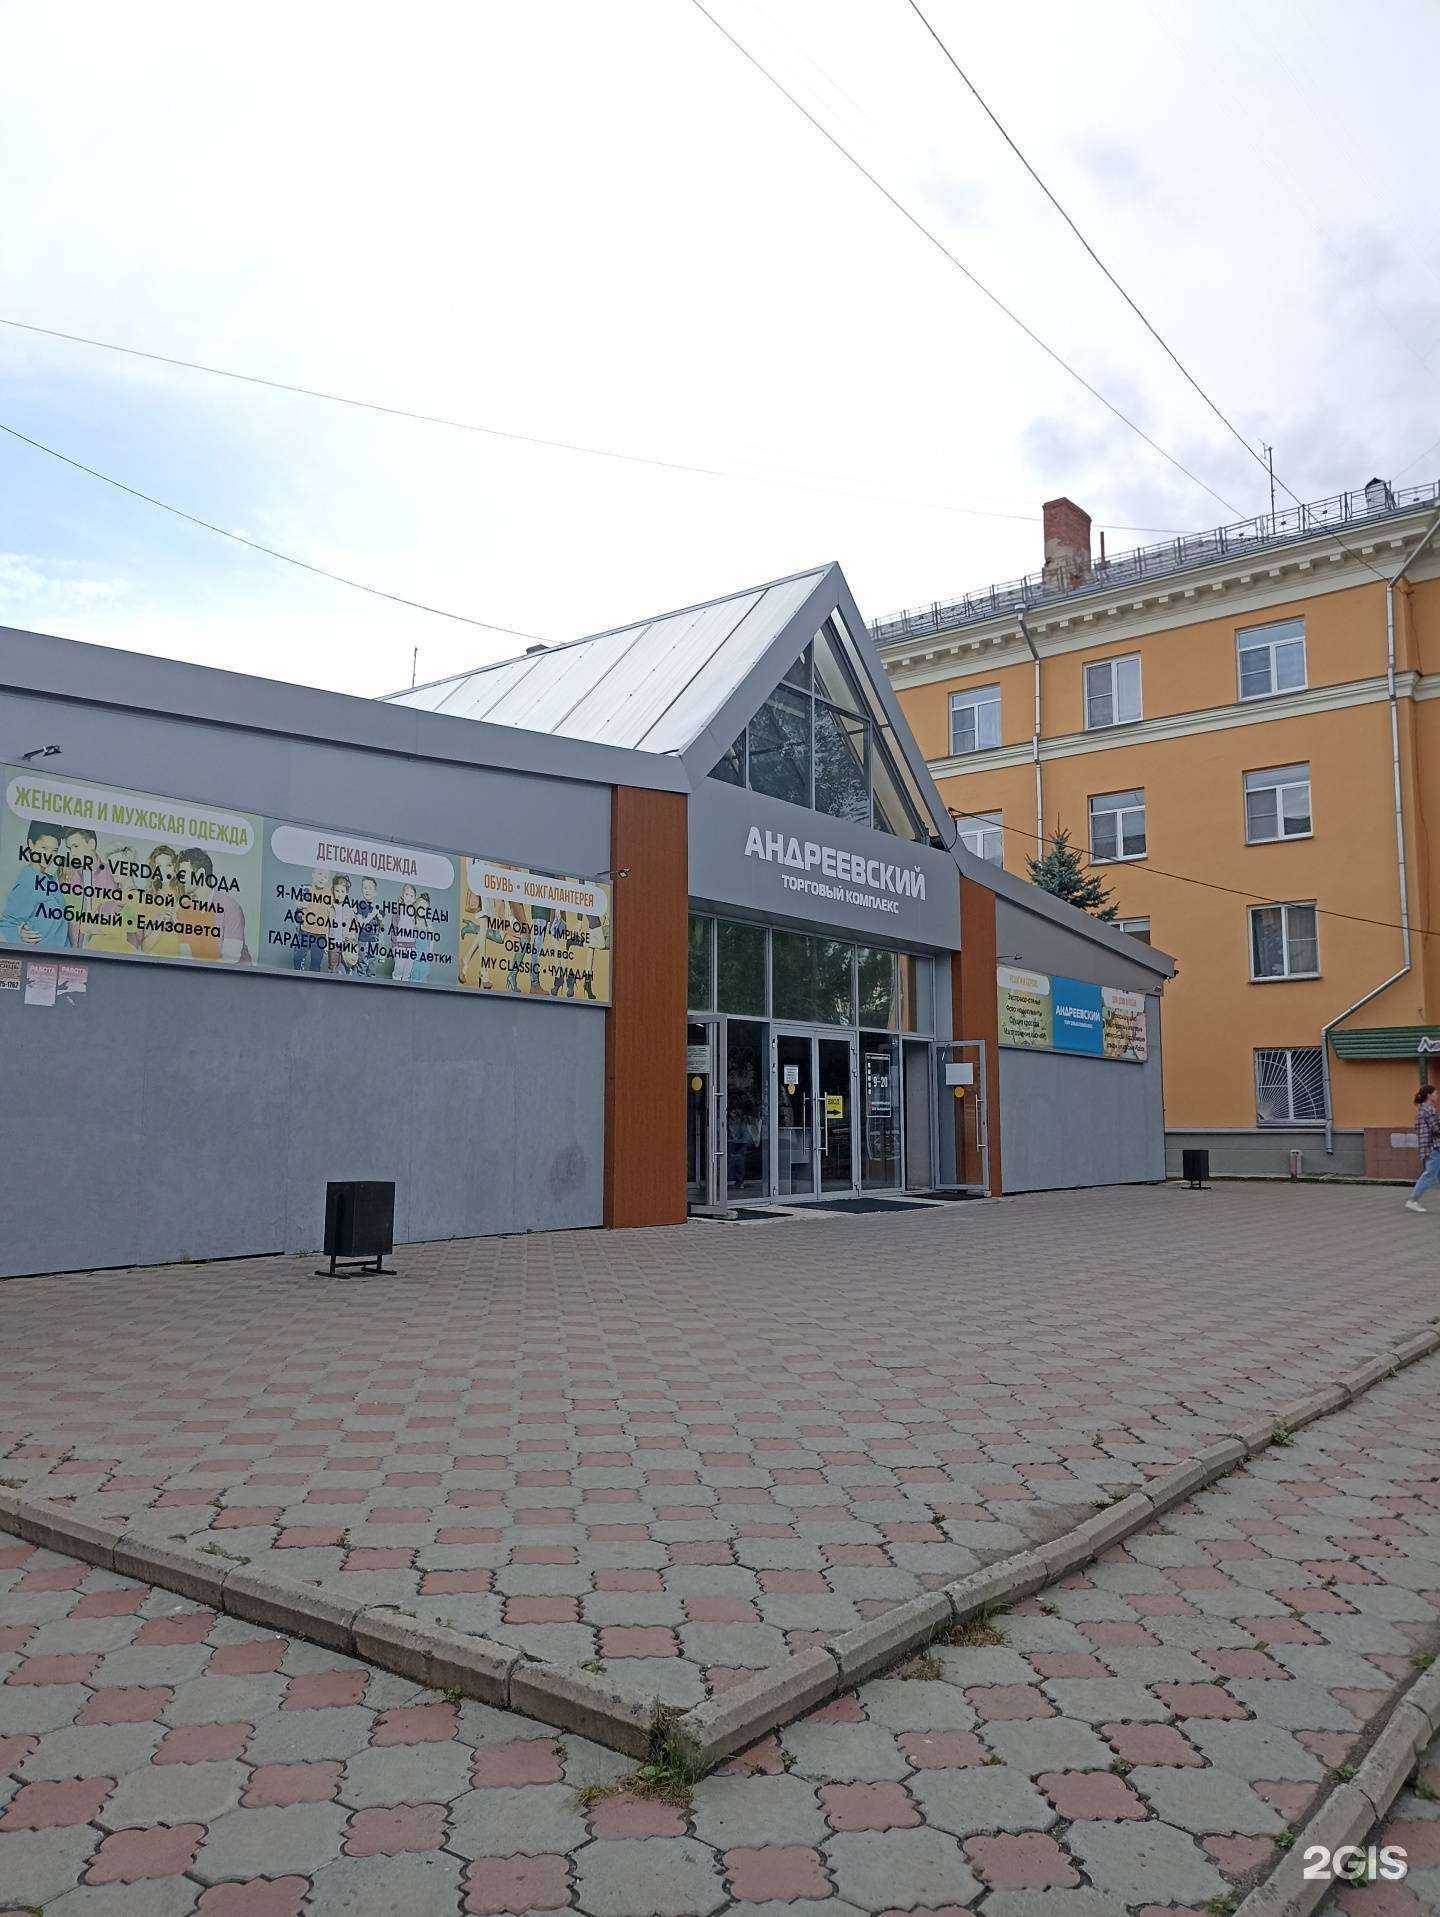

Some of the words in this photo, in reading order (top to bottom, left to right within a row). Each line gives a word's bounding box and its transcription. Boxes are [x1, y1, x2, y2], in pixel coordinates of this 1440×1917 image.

[15, 786, 93, 818] ЖЕНСКАЯ
[97, 803, 107, 821] И
[112, 804, 185, 835] МУЖСКАЯ
[189, 819, 248, 846] ОДЕЖДА
[19, 845, 93, 870] KavaleR
[108, 859, 163, 881] VERDA
[191, 872, 240, 892] МОДА
[317, 842, 368, 866] ДЕТСКАЯ
[371, 852, 417, 876] ОДЕЖДА
[744, 826, 926, 900] АНДРЕЕВСКИЙ
[34, 875, 122, 900] Красотка
[137, 889, 174, 908] Твой
[179, 894, 224, 914] Стиль
[276, 885, 332, 904] Я-Мама
[342, 895, 373, 911] Аист
[383, 901, 449, 923] НЕПОСЕДЫ
[484, 874, 513, 893] ОБУВЬ
[524, 882, 594, 907] КОЖГАЛАНТЕРЕЯ
[781, 874, 844, 901] ТОРГОВЫЙ
[845, 889, 899, 914] КОМПЛЕКС
[34, 903, 122, 927] Любимый
[137, 915, 220, 938] Елизавета
[284, 910, 338, 928] АССоль
[349, 918, 378, 935] Дуэт
[388, 924, 441, 942] Лимпопо
[487, 918, 511, 931] МИР
[513, 922, 547, 936] ОБУВИ
[269, 930, 358, 953] ГАРДЕРОБчик
[368, 943, 417, 960] Модные
[420, 952, 452, 964] детки
[539, 948, 555, 958] для
[557, 951, 574, 960] вас
[481, 957, 497, 969] MY
[499, 959, 541, 974] CLASSIC
[549, 965, 594, 980] ЧУМАДАН
[1055, 1005, 1100, 1022] АНДРЕЕВСКИЙ
